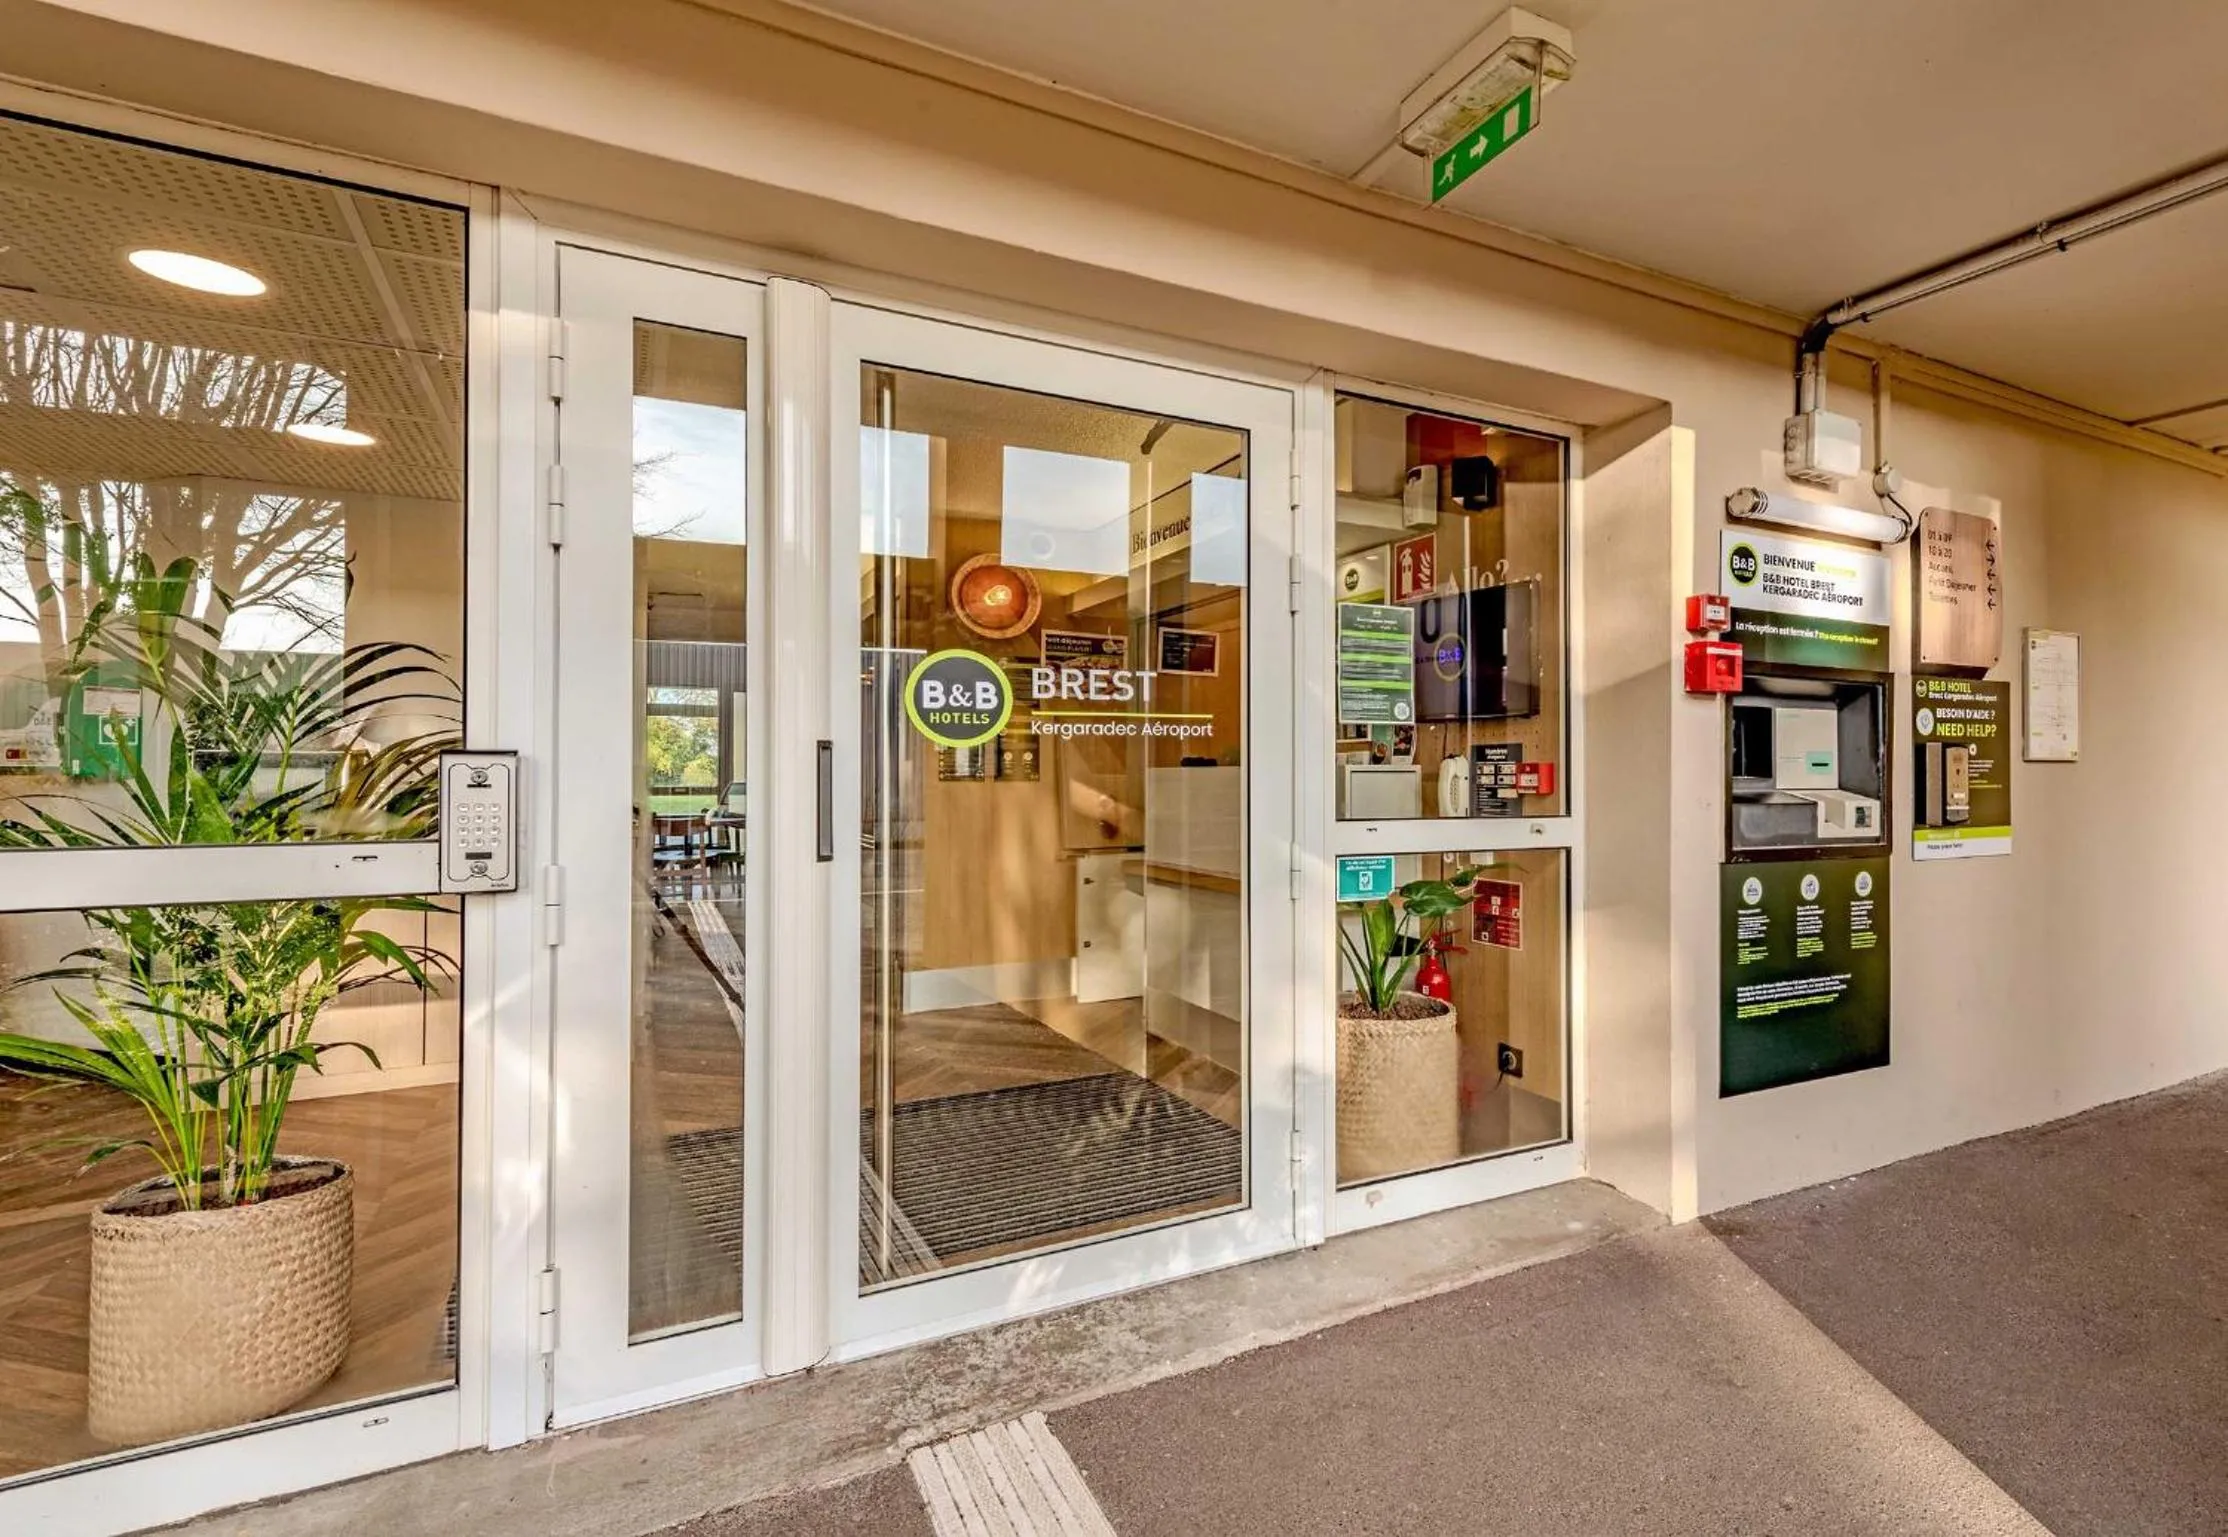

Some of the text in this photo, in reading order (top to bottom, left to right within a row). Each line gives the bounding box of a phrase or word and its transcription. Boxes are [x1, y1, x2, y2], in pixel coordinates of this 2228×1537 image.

[1732, 555, 1755, 571] B&B
[1763, 553, 1816, 572] BIENVENUE
[1762, 573, 1836, 592] B&B HOTEL BREST
[1762, 583, 1820, 600] KERGARADEC
[1735, 621, 1744, 630] La
[1031, 667, 1158, 702] BREST
[1928, 681, 1946, 692] B&B
[1947, 682, 1971, 693] HOTEL
[922, 680, 998, 709] B&B
[929, 711, 990, 724] HOTELS
[1936, 707, 1965, 719] BESOIN
[1966, 709, 1990, 719] D'AIDE
[1031, 720, 1214, 740] Kergaradec Aéroport
[1936, 722, 1997, 737] NEED HELP?
